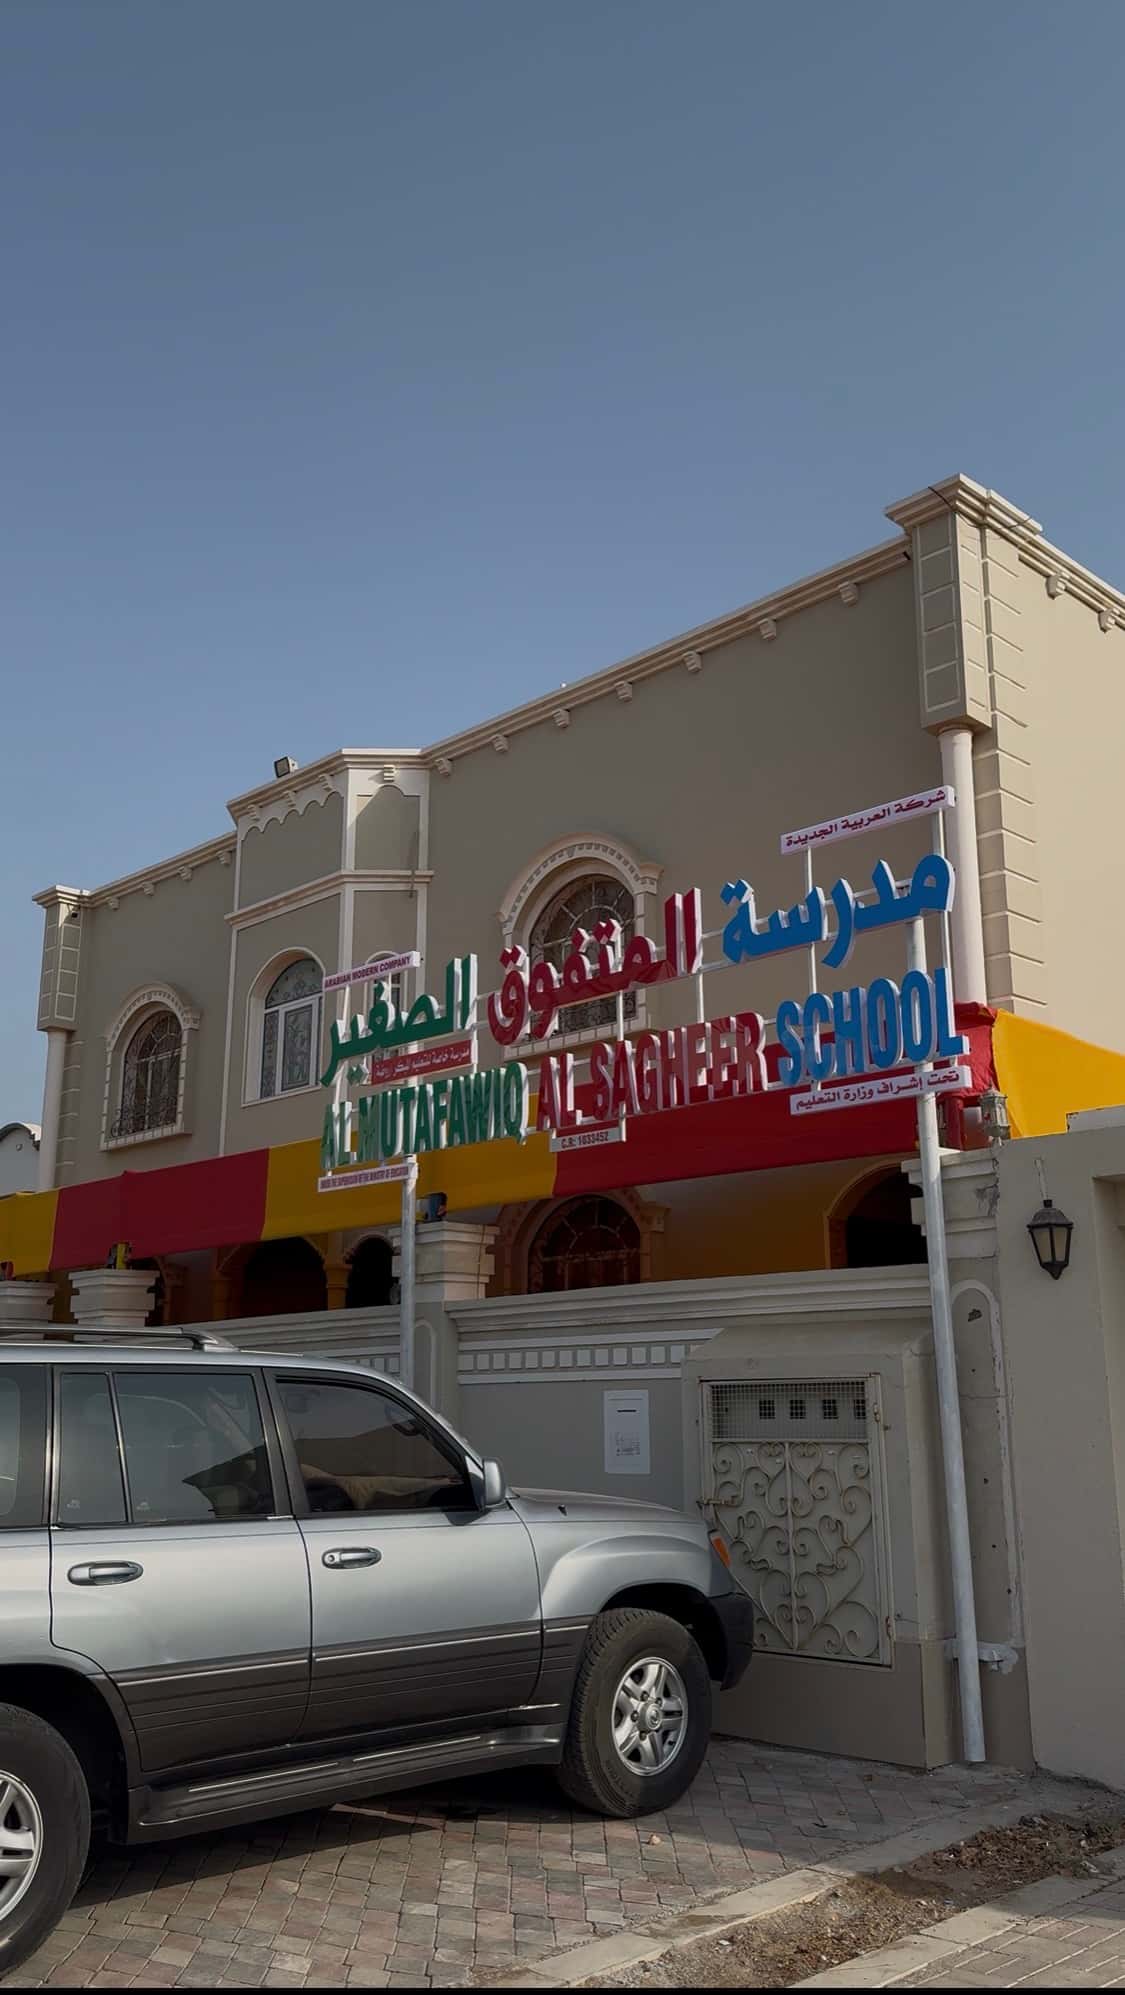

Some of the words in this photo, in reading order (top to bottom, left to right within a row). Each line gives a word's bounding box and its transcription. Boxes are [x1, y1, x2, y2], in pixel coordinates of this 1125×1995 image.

[894, 789, 947, 815] شركة
[841, 807, 891, 832] العربية
[786, 823, 838, 847] الجديدة
[720, 854, 955, 969] مدرسة
[352, 965, 379, 980] MODERN
[380, 956, 411, 972] COMPANY
[487, 887, 700, 1046] المتفوق
[320, 953, 477, 1087] الصغير
[321, 1101, 356, 1169] AL
[358, 1062, 527, 1161] MUTAFAWIQ
[536, 1053, 582, 1131] AL
[590, 1011, 767, 1121] SAGHEER
[776, 967, 969, 1086] SCHOOL
[927, 1069, 960, 1086] تحت
[843, 1085, 874, 1101] وزارة
[876, 1076, 922, 1095] إشراف
[796, 1091, 840, 1110] التعليم
